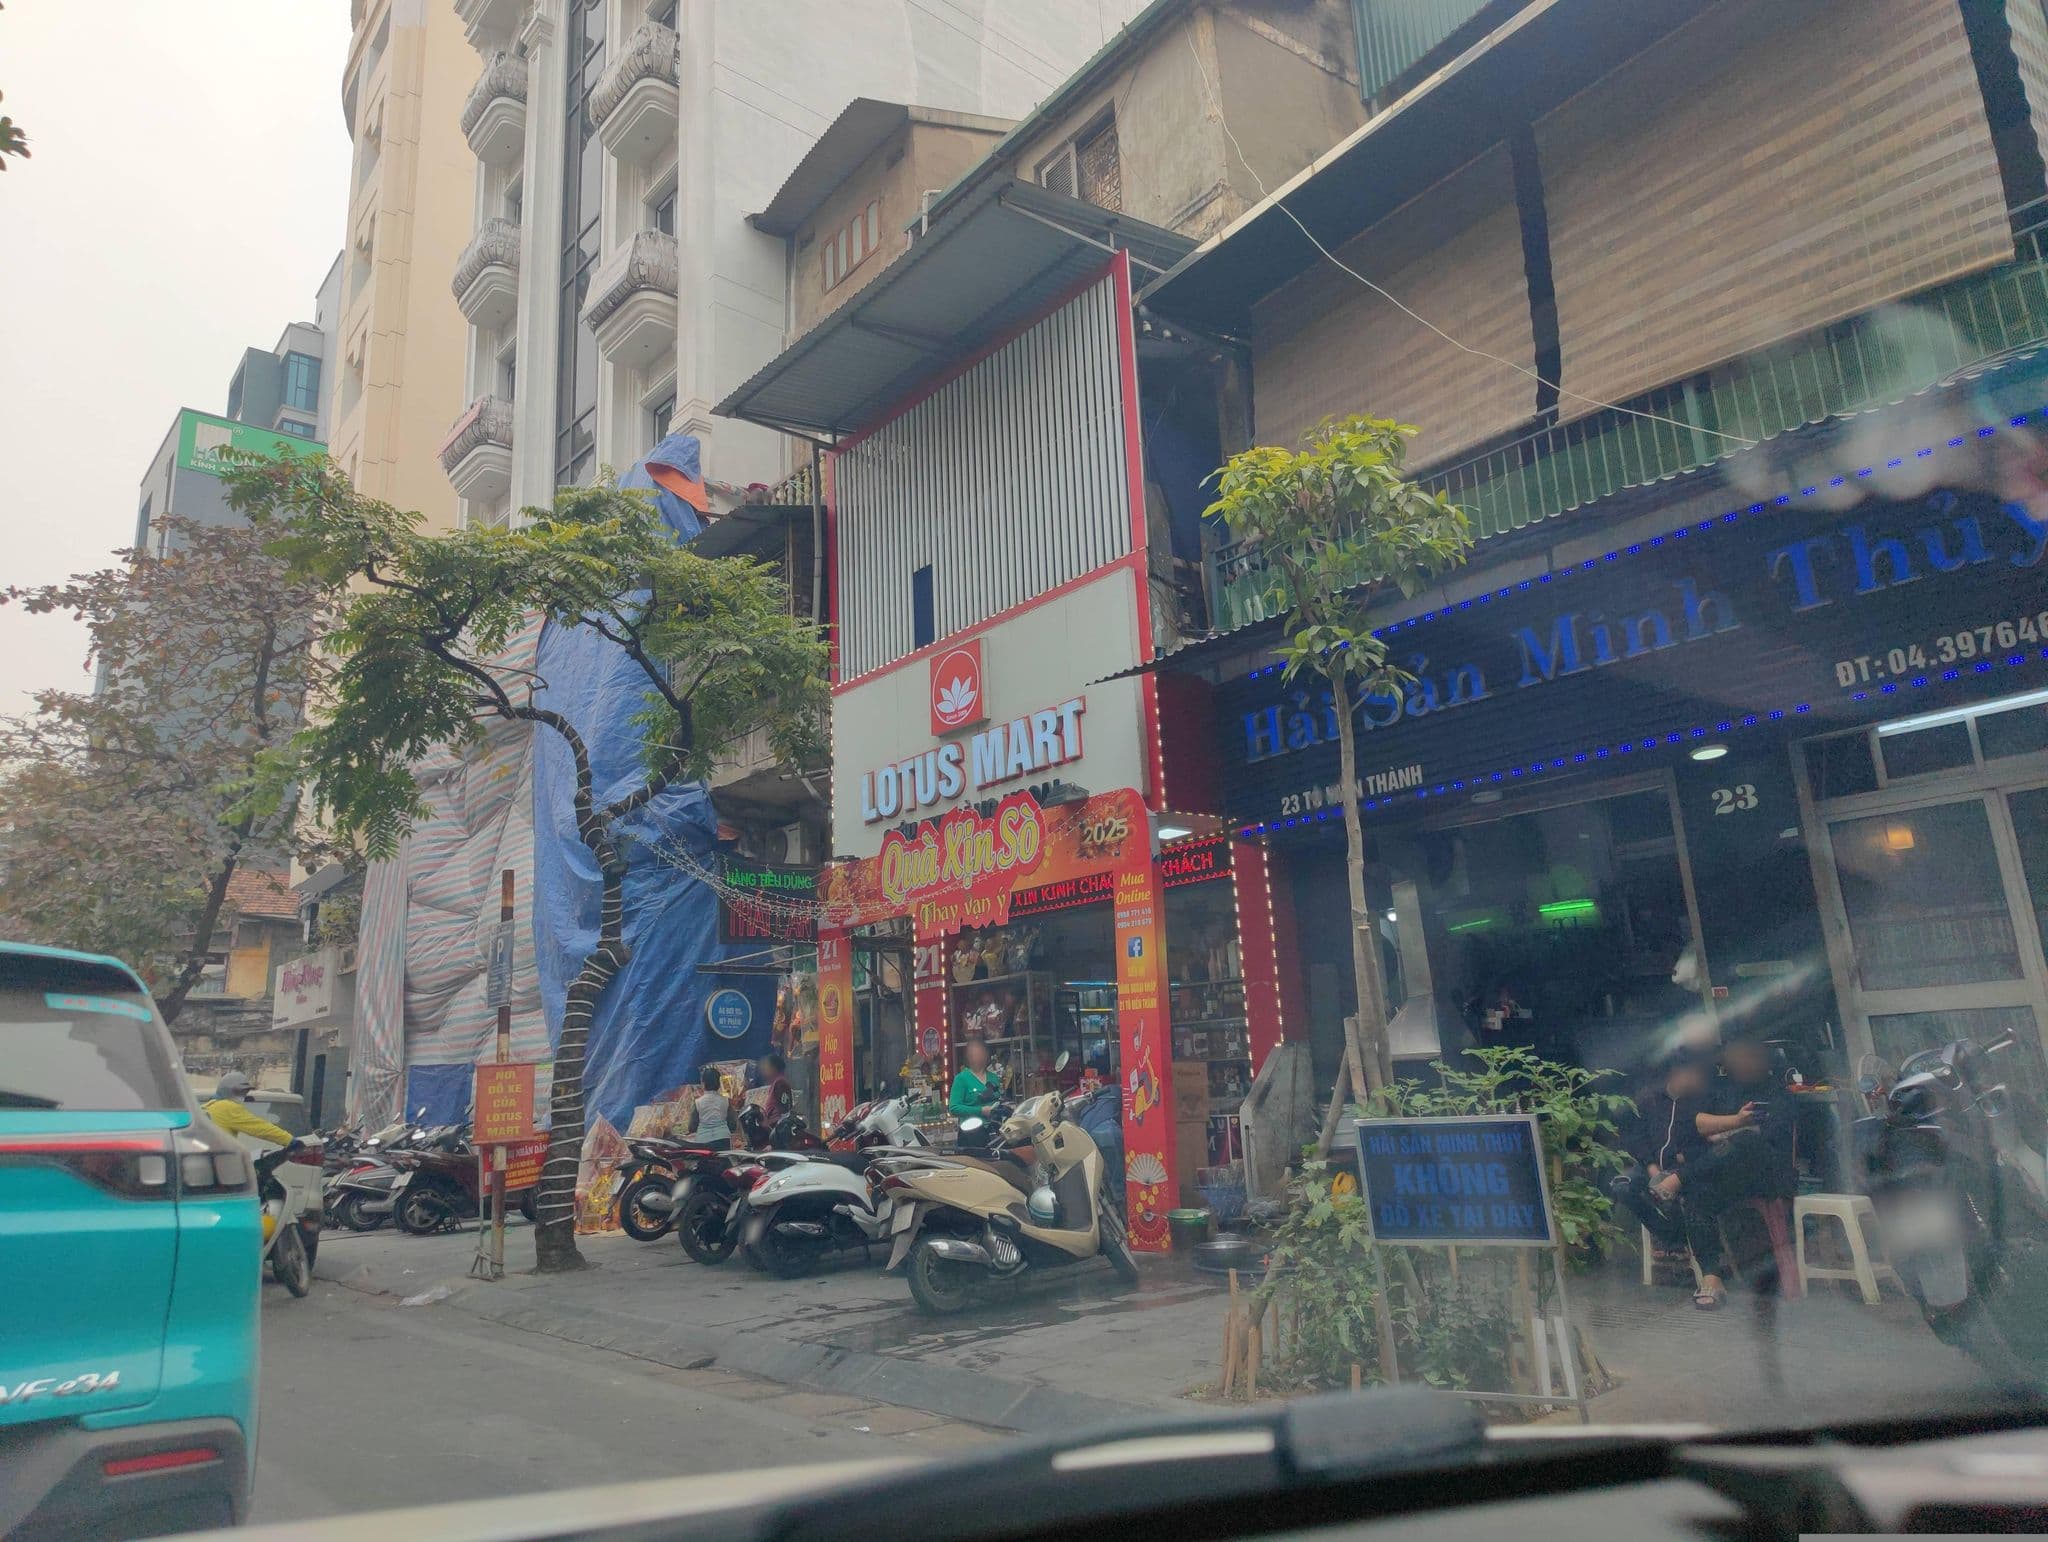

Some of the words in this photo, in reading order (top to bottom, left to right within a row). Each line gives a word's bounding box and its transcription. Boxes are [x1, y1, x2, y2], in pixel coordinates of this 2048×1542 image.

[1511, 576, 1742, 688] Minh
[861, 742, 965, 826] LOTUS
[971, 696, 1086, 791] MART
[1281, 793, 1300, 816] 23
[1366, 764, 1423, 796] THÀNH
[1712, 783, 1758, 816] 23
[1082, 816, 1129, 846] 2025
[882, 832, 939, 906] Quà
[942, 818, 995, 890] Xịn
[997, 802, 1041, 870] Sò
[726, 867, 757, 887] HÀNG
[784, 871, 814, 891] DÙNG
[1120, 872, 1145, 888] Mua
[1116, 889, 1151, 905] Online
[921, 901, 959, 930] Thay
[822, 940, 838, 960] 21
[915, 944, 940, 978] 21
[824, 1032, 838, 1055] Hộp
[496, 1069, 517, 1081] NƠI
[820, 1063, 833, 1085] Quà
[834, 1059, 844, 1081] Tết
[493, 1096, 517, 1109] CỦA
[486, 1111, 523, 1122] LOTUS
[486, 1125, 521, 1137] MART
[1392, 1155, 1510, 1197] KHÔNG
